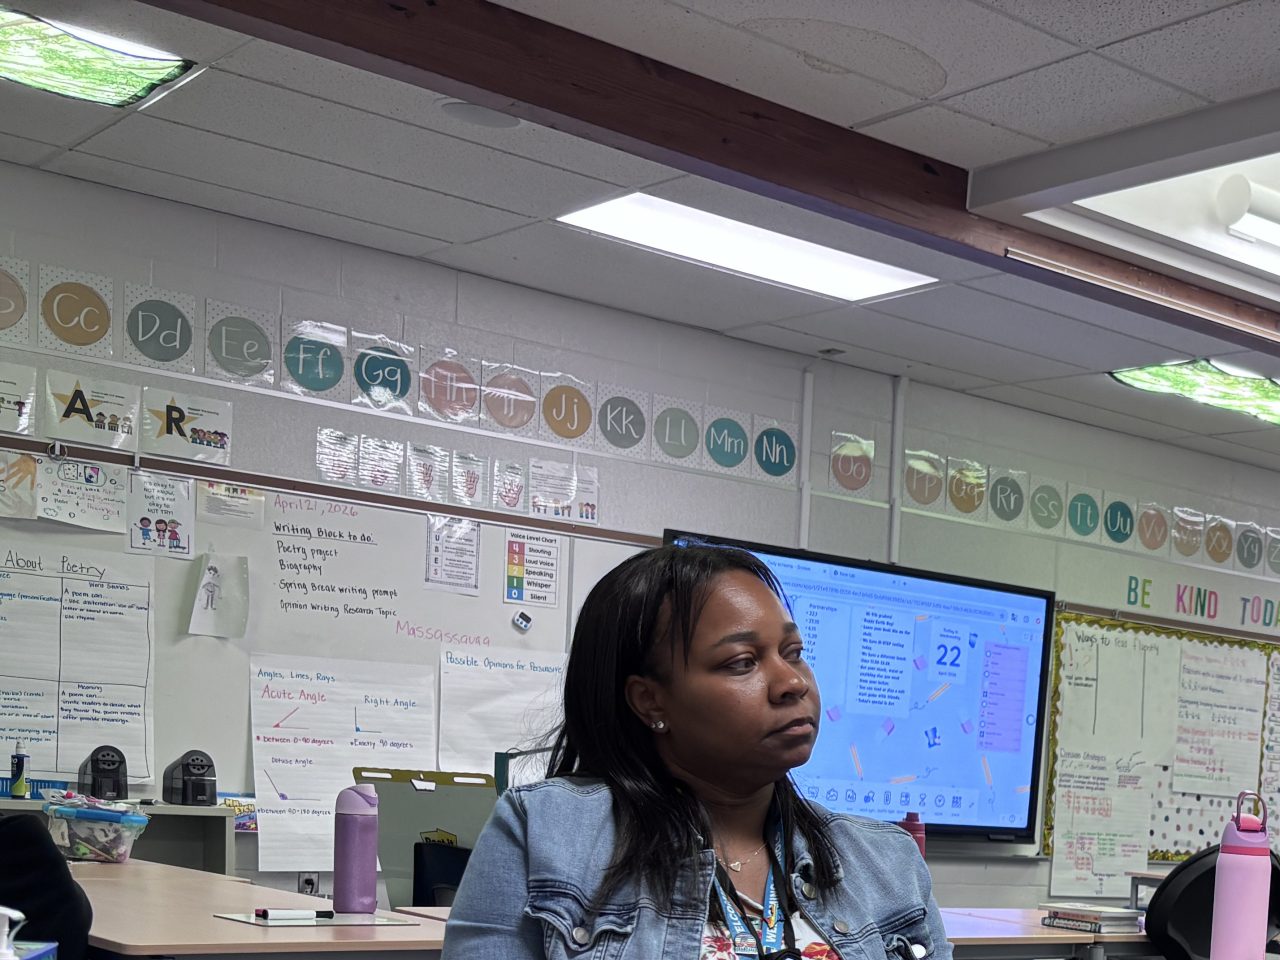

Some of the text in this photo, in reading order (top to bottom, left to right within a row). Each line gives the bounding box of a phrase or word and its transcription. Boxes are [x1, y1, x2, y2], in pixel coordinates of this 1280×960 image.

[53, 293, 99, 331] Cc
[138, 310, 182, 349] Dd
[221, 326, 262, 363] Ee
[298, 343, 331, 379] Ff
[361, 355, 401, 395] Gg
[62, 389, 94, 422] A
[553, 394, 580, 430] Jj
[166, 405, 189, 437] R
[606, 407, 639, 438] Kk
[665, 417, 686, 446] Ll
[709, 428, 744, 456] Mm
[762, 436, 789, 466] Nn
[838, 456, 867, 480] Oo
[912, 467, 937, 496] Pp
[274, 494, 302, 513] April
[997, 485, 1018, 508] Rr
[1034, 494, 1058, 519] Ss
[1072, 502, 1094, 526] Tt
[1106, 509, 1130, 535] Uu
[274, 522, 312, 540] Writing
[317, 528, 344, 538] Block
[349, 531, 357, 541] to
[511, 532, 557, 545] Voice Level Chart
[1143, 519, 1164, 540] Vv
[277, 540, 338, 561] Poetry project
[513, 543, 552, 556] 4 Shouting
[1208, 532, 1230, 553] Xx
[1241, 535, 1259, 559] Yy
[5, 550, 106, 580] About Poetry
[279, 559, 322, 576] Biography
[525, 569, 554, 578] Speaking
[279, 579, 398, 600] Spring Break writing prompt
[512, 589, 547, 601] 0 Silent
[527, 580, 552, 589] Whisper
[1127, 576, 1152, 609] BE
[1176, 583, 1219, 619] KIND
[281, 600, 307, 613] Opinion
[378, 607, 397, 619] Topic
[1075, 630, 1098, 647] Ways
[1102, 635, 1110, 646] to
[445, 651, 478, 667] Possible
[484, 658, 514, 670] Opinions
[516, 660, 526, 670] for
[936, 644, 961, 667] 22
[257, 668, 336, 683] Angles, Lines, Rays
[261, 685, 327, 704] Acute Angle
[364, 695, 417, 710] Right Angle
